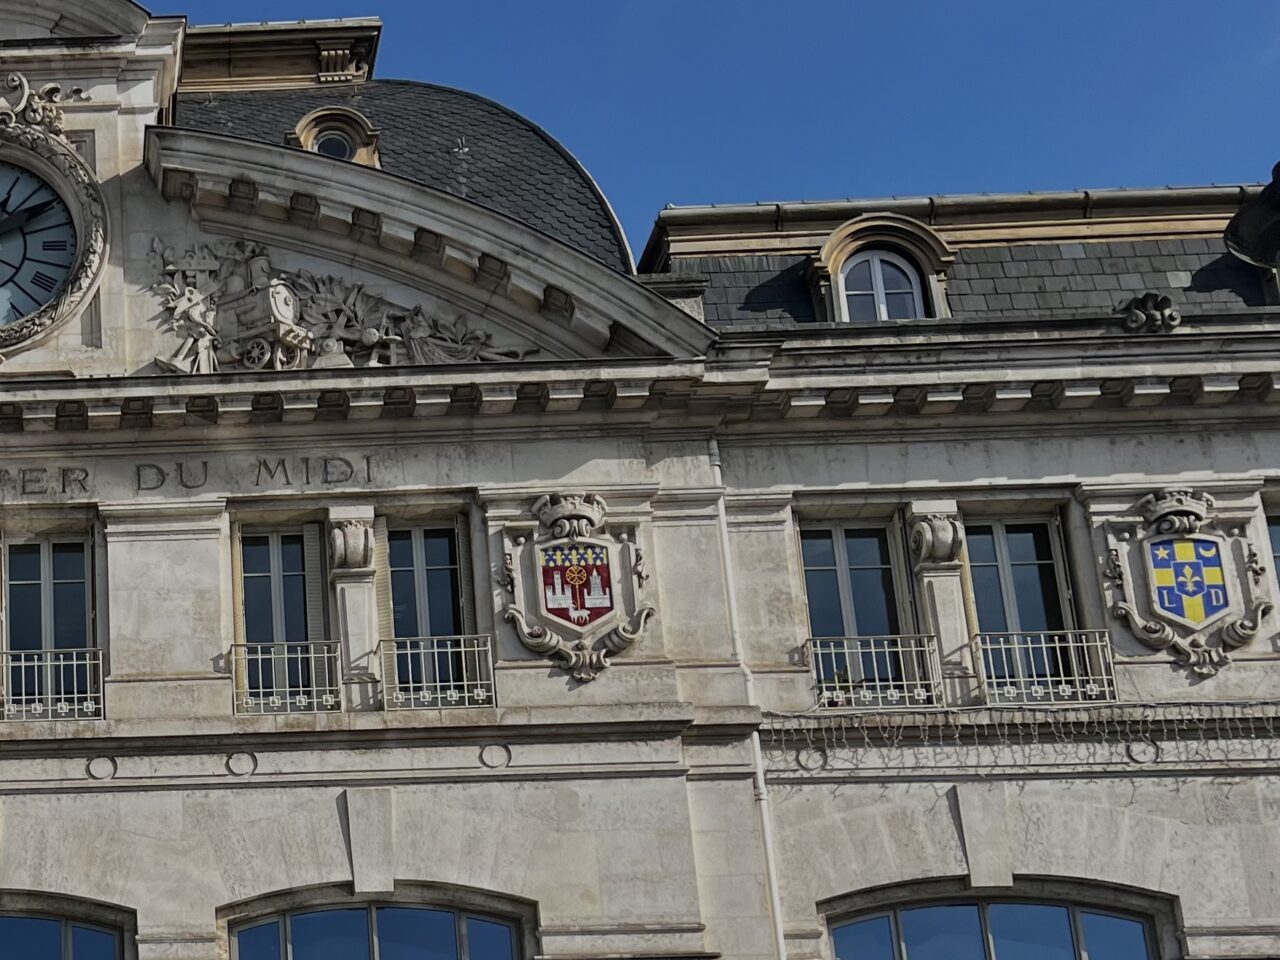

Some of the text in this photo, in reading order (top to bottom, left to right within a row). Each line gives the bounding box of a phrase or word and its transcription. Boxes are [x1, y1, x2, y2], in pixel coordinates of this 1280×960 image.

[42, 240, 68, 251] III
[135, 460, 209, 491] DU
[255, 455, 373, 486] MIDI
[1161, 588, 1225, 608] L D
